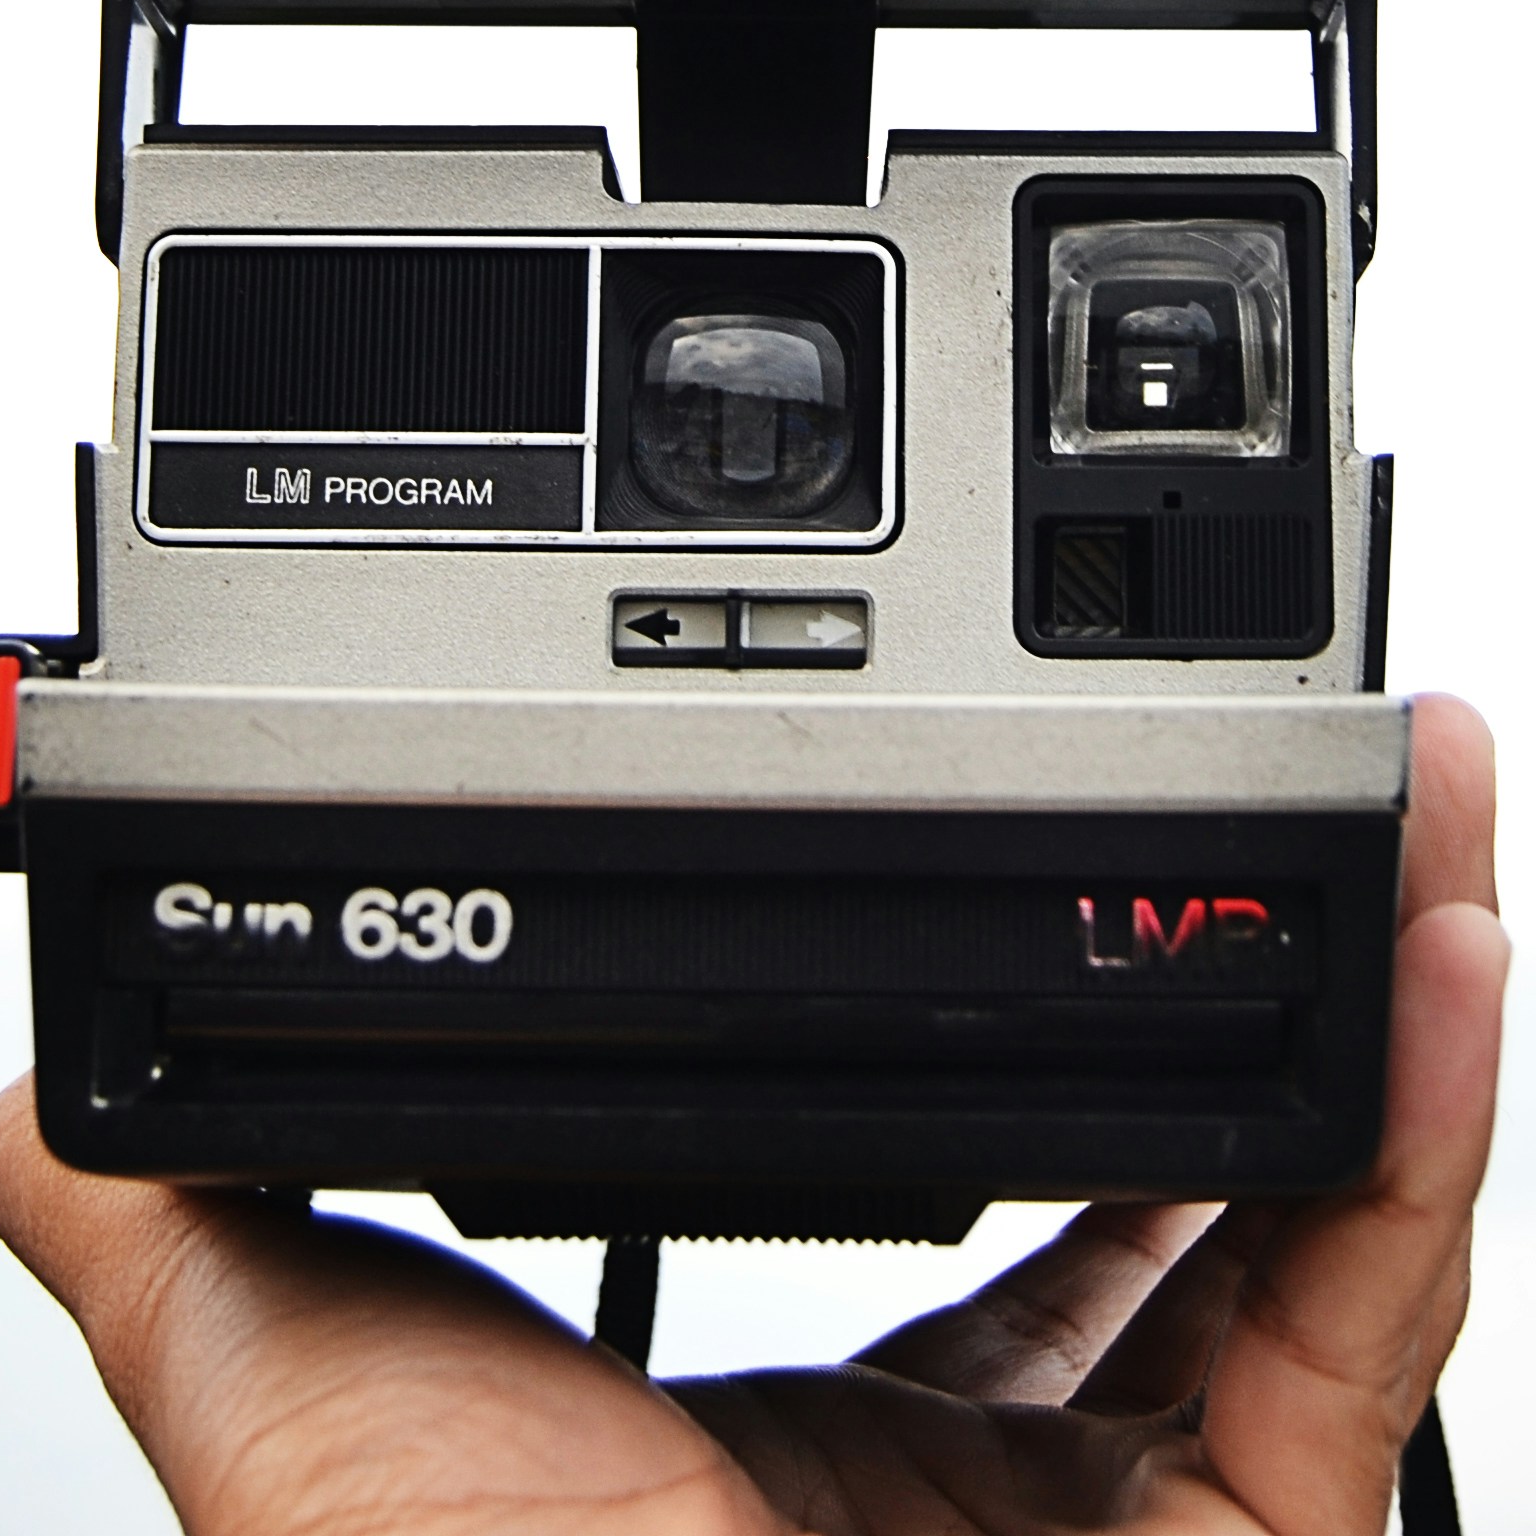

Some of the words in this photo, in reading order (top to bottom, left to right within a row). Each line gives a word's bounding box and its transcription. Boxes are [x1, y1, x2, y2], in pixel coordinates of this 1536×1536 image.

[245, 467, 312, 505] LM
[324, 476, 494, 506] PROGRAM
[340, 886, 514, 963] 630
